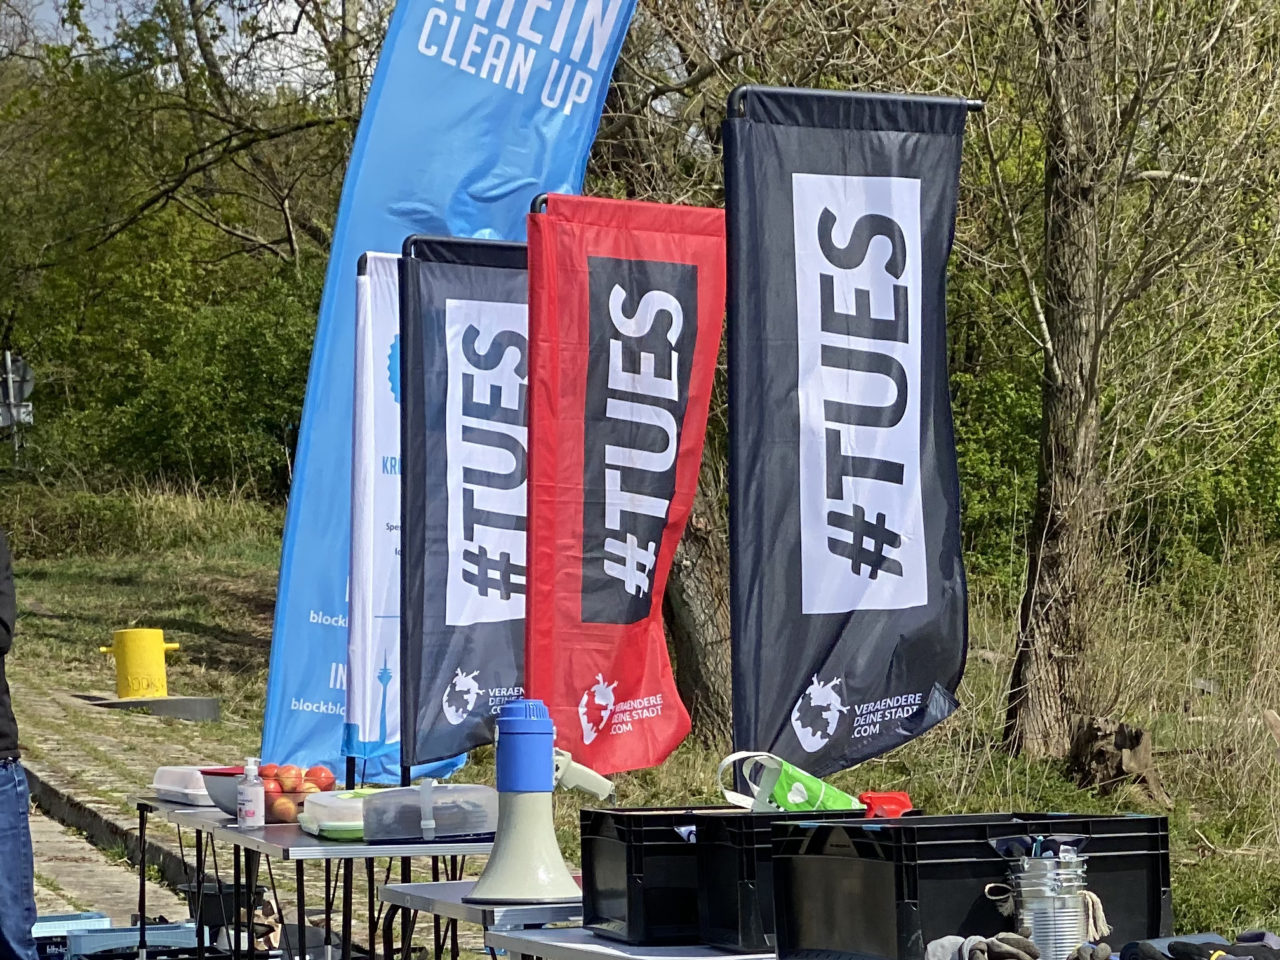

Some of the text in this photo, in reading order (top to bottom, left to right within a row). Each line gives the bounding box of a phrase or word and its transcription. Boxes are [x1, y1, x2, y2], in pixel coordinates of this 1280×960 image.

[417, 7, 593, 116] CLEAN UP
[817, 206, 909, 580] #TUES
[604, 283, 683, 598] #TUES
[632, 705, 663, 720] STADT
[854, 693, 923, 715] VERAENDERE
[853, 711, 883, 727] DEINE
[851, 723, 880, 738] .COM
